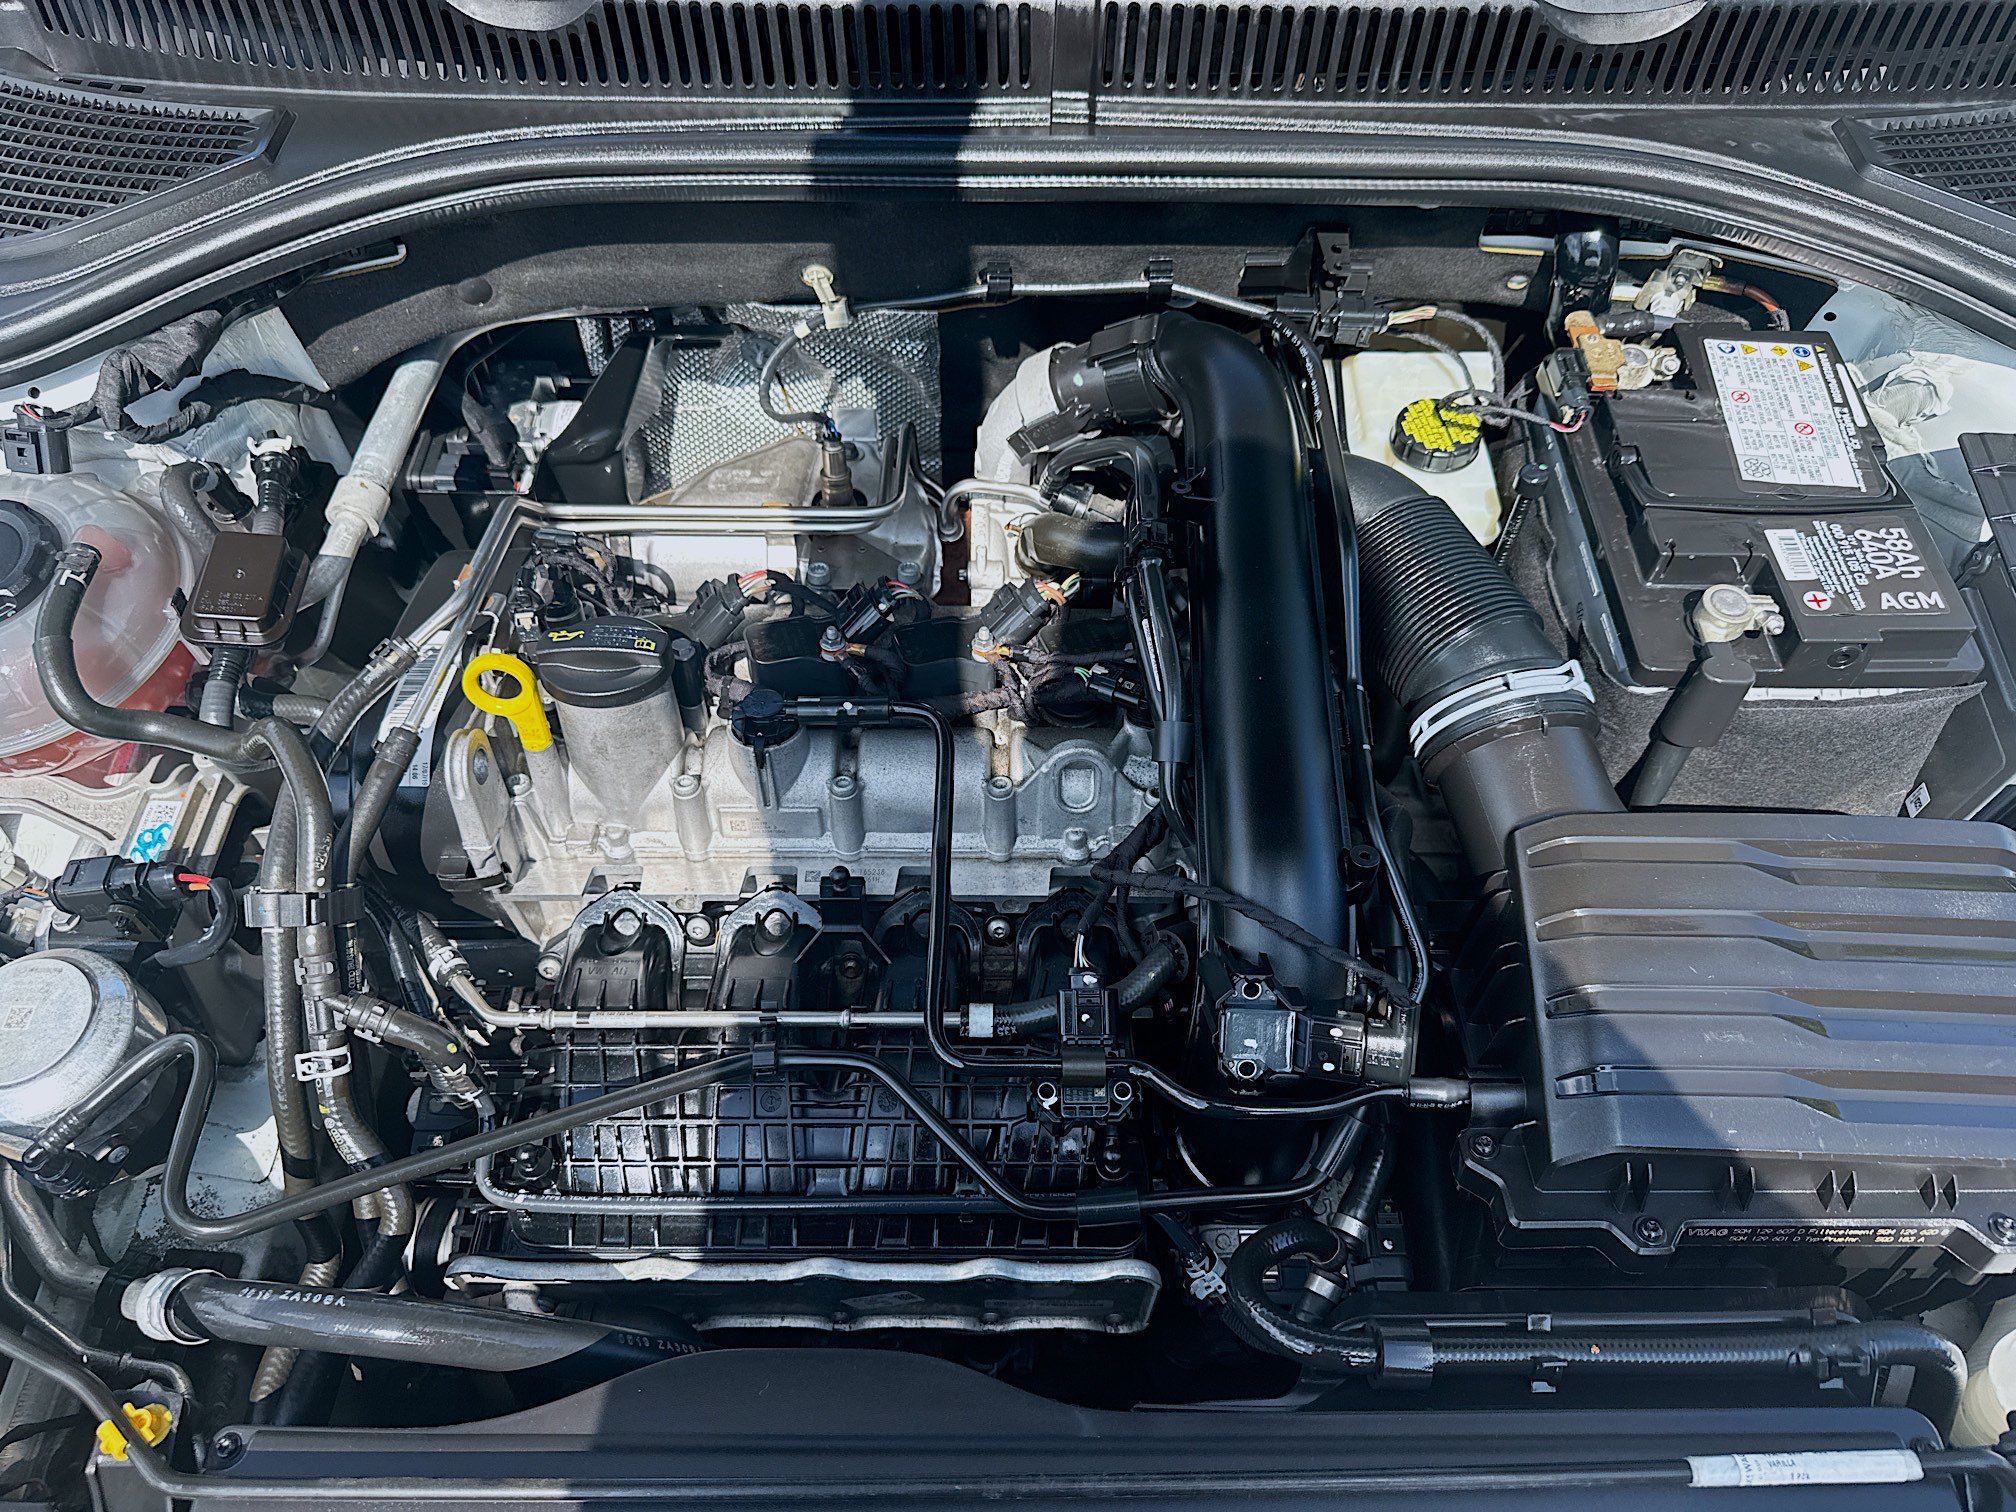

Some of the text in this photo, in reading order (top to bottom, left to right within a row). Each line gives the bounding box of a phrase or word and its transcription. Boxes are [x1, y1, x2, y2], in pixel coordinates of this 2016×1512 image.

[1829, 524, 1845, 538] 000
[1837, 540, 1853, 554] 915
[1845, 556, 1861, 571] 105
[1854, 528, 1896, 580] 640A
[1879, 527, 1926, 579] 58Ah
[1881, 591, 1945, 610] AGM
[588, 966, 628, 976] VW AG
[1688, 1228, 1728, 1237] VWAG
[1808, 1228, 1874, 1236] Filterelement
[1899, 1228, 1918, 1236] 129
[1920, 1228, 1939, 1236] 620
[1767, 1459, 1797, 1468] VARILLA
